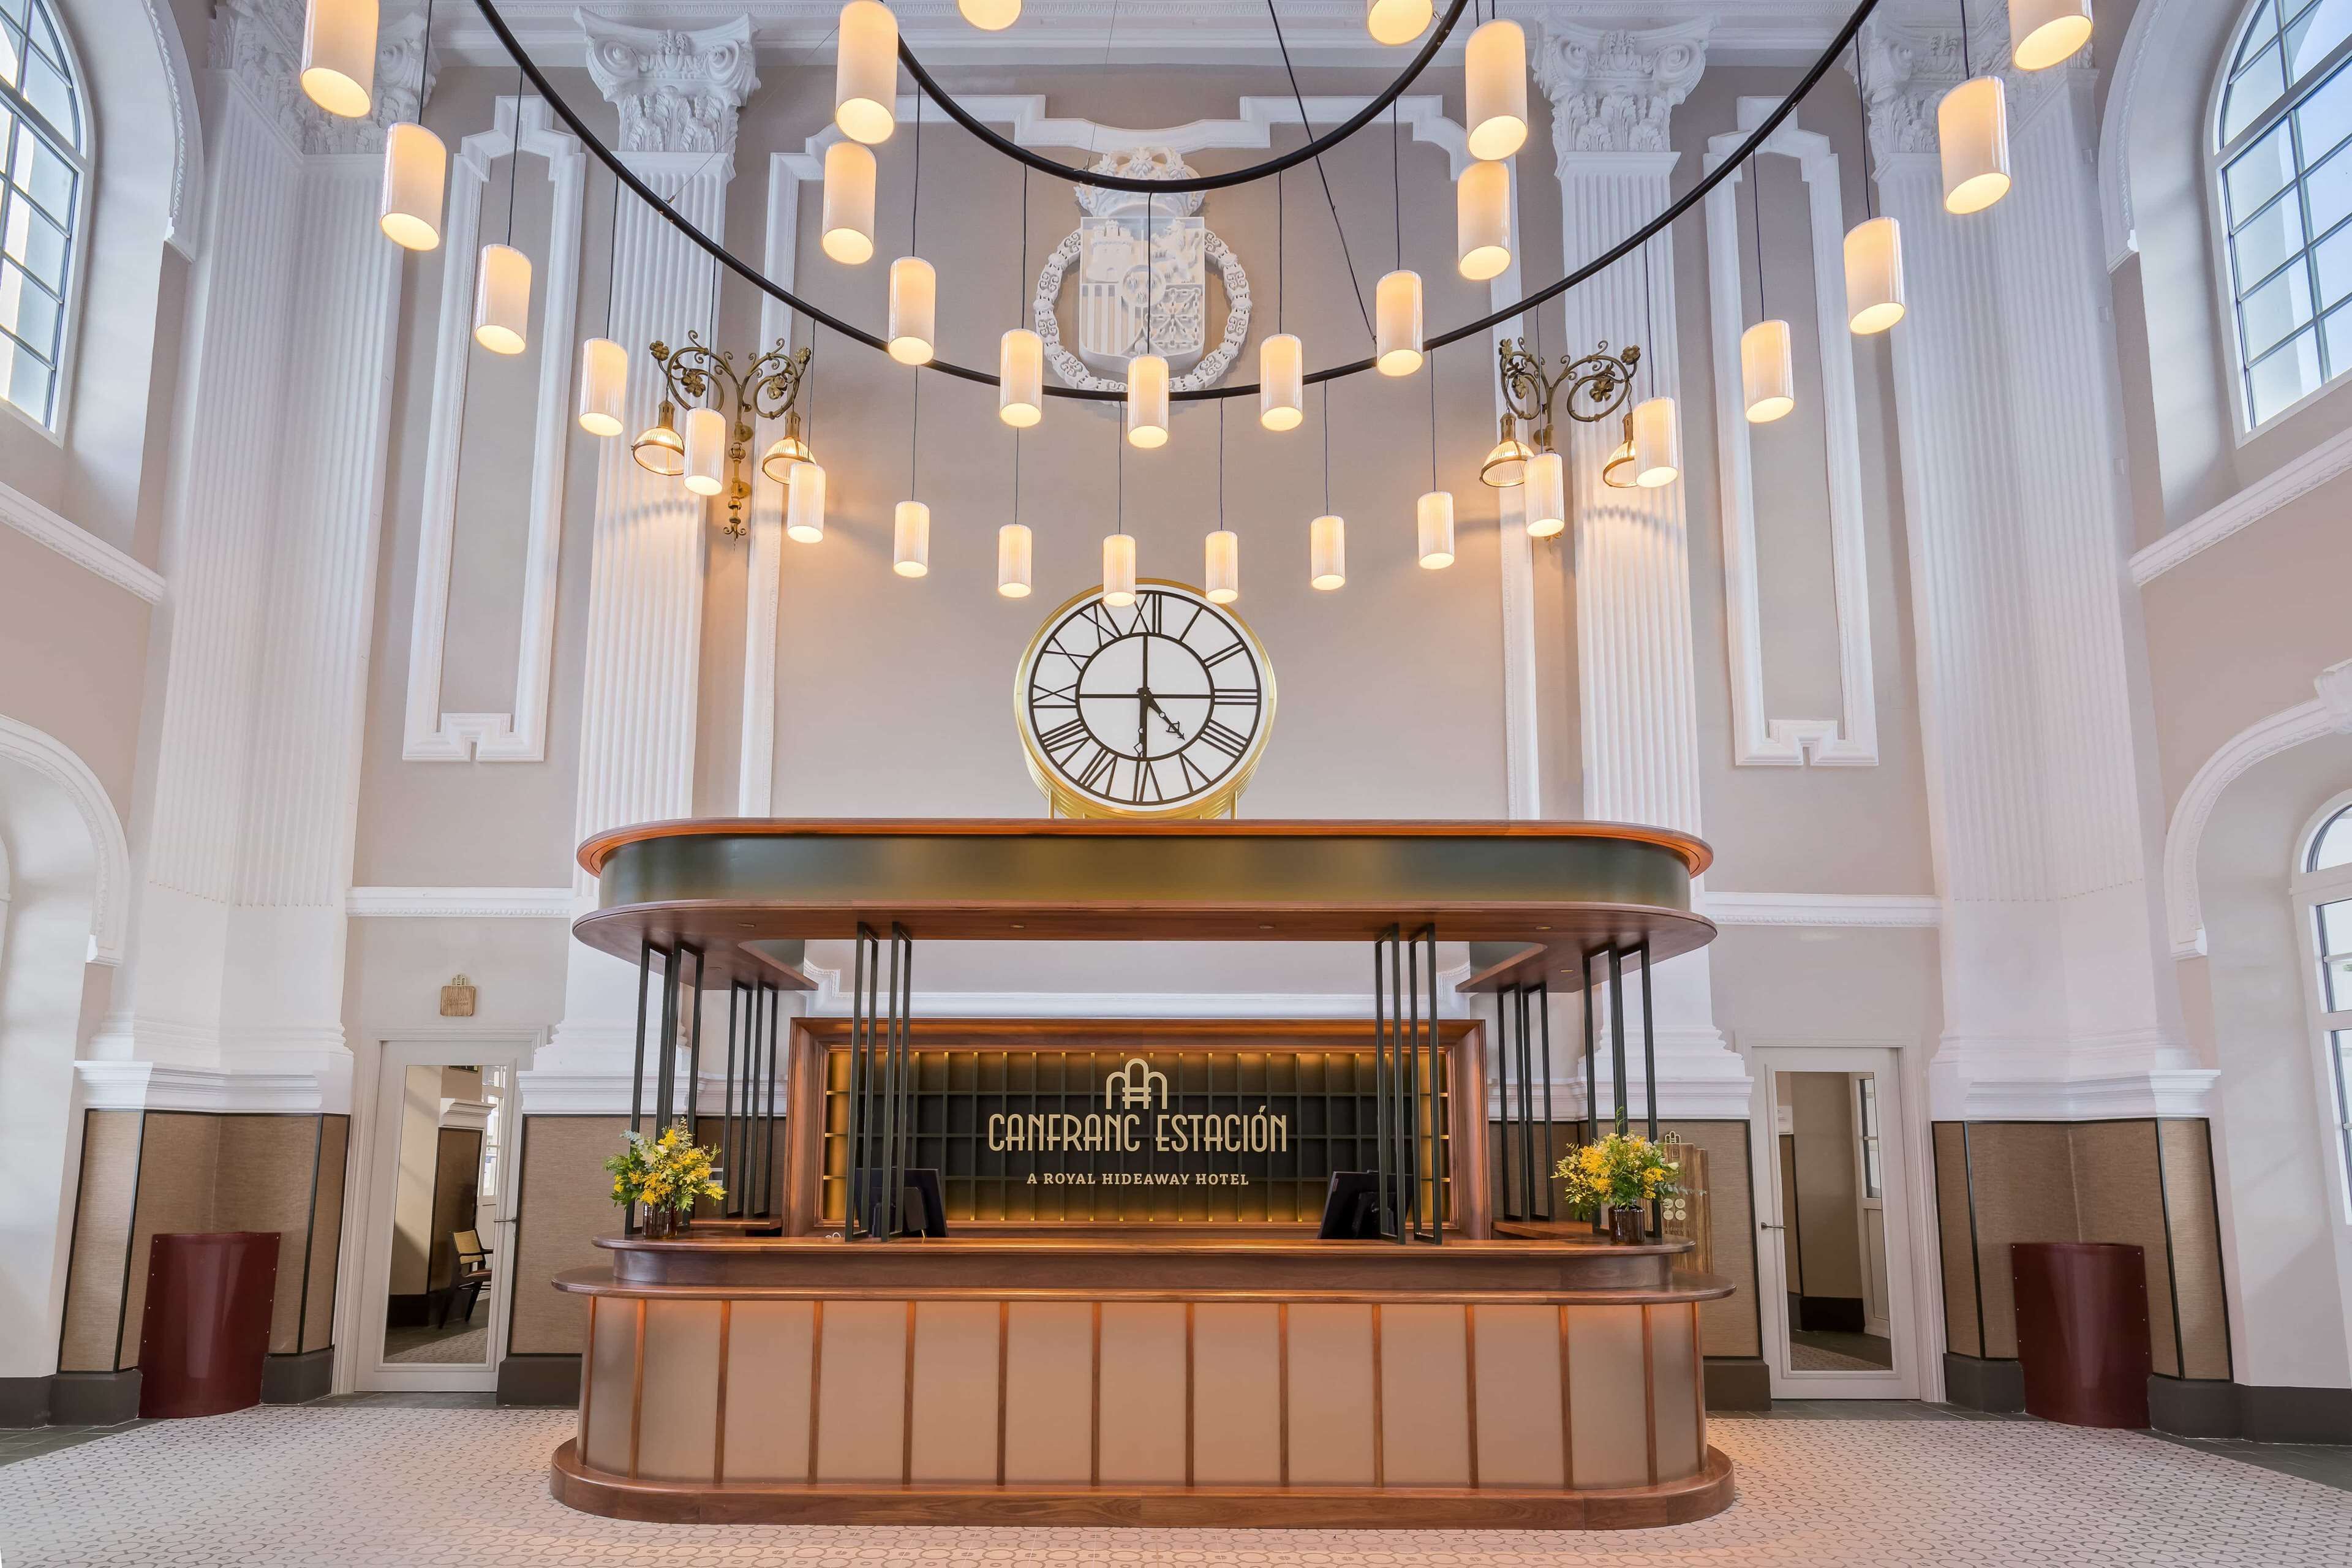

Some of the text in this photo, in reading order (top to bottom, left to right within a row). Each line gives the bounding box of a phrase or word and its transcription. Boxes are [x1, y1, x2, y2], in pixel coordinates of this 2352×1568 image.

[989, 1105, 1287, 1152] CANFRANC ESTACIÓN
[1027, 1173, 1249, 1185] A ROYAL HIDEAWAY HOTEL
